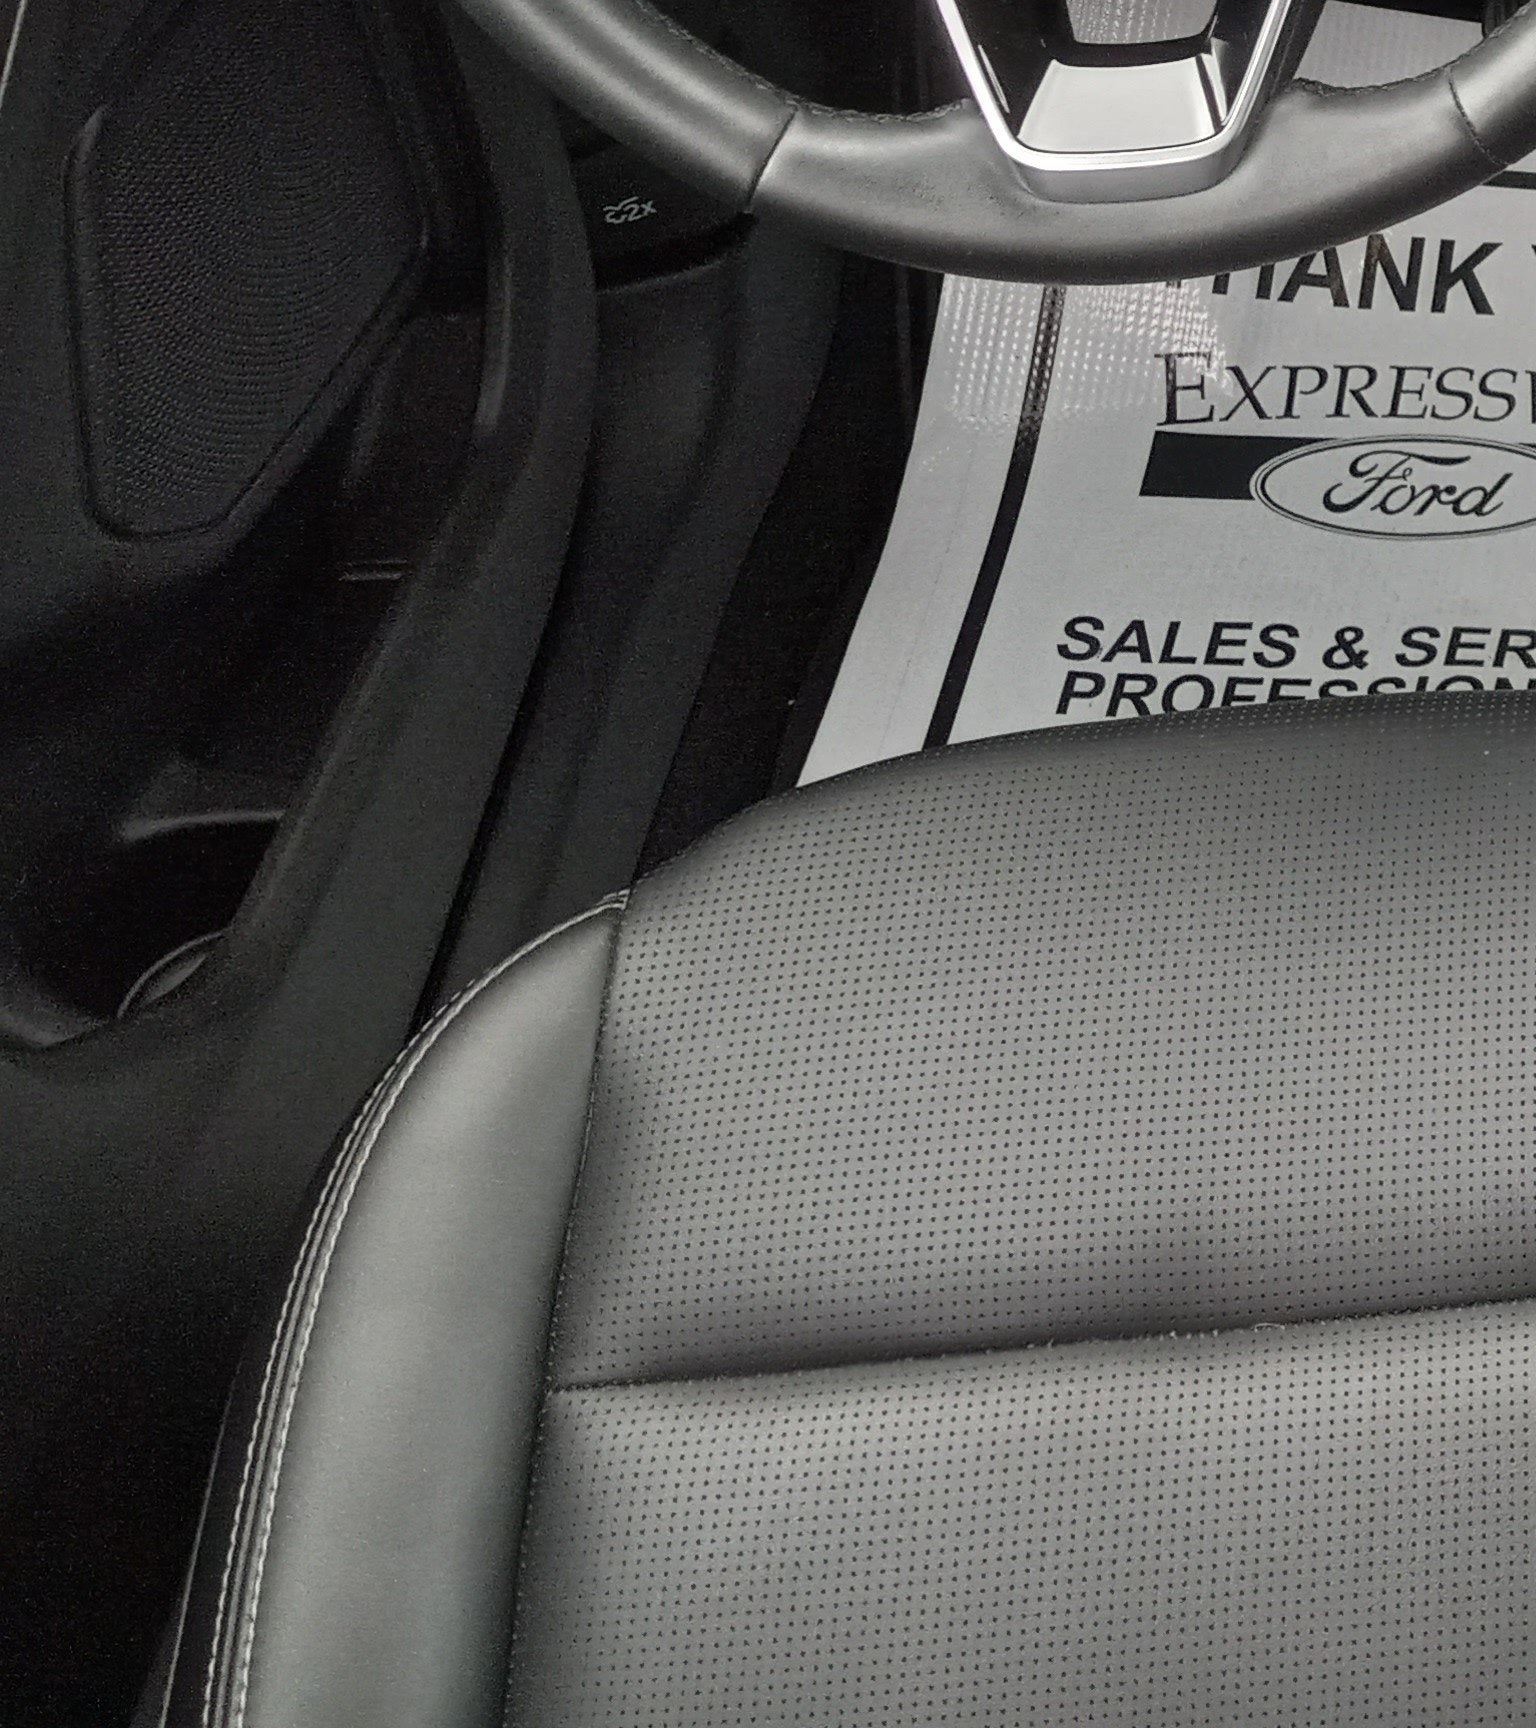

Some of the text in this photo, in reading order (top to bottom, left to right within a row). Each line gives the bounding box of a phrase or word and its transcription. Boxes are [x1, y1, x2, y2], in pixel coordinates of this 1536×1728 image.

[1167, 234, 1501, 314] ANK
[1321, 448, 1513, 519] Ford
[1056, 616, 1300, 669] SALES
[1323, 627, 1368, 669] &
